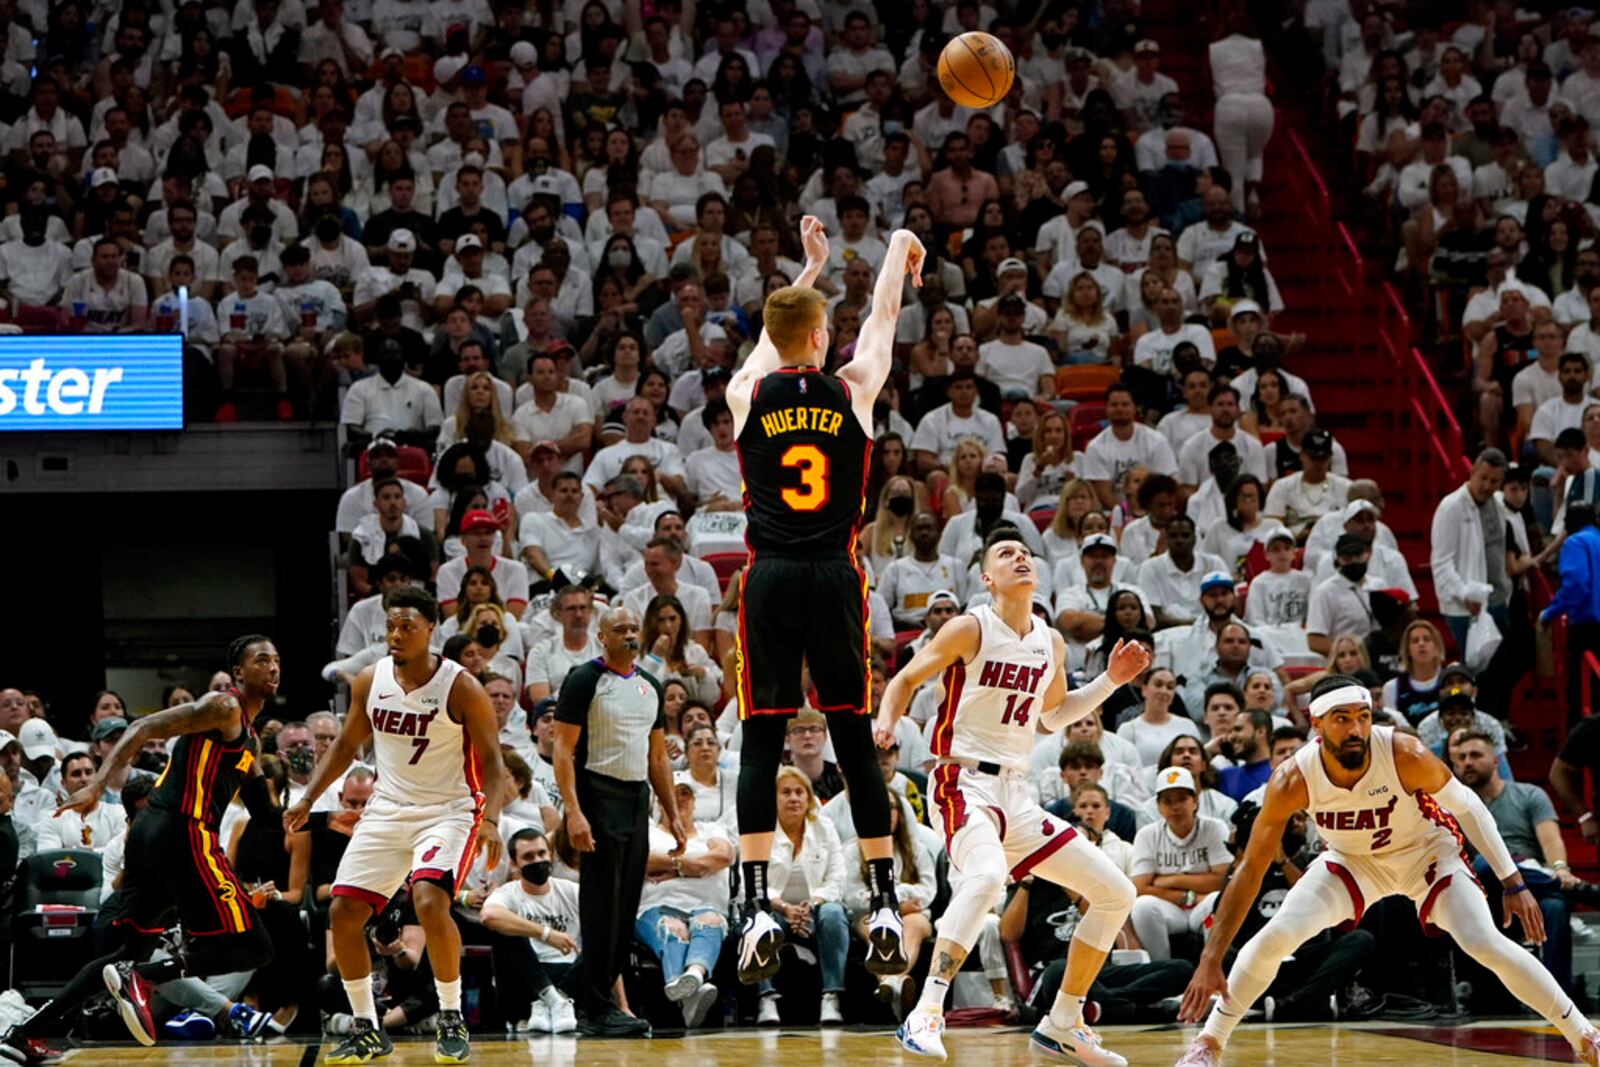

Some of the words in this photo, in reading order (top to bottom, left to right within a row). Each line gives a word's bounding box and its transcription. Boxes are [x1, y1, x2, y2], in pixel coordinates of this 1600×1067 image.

[761, 406, 843, 438] HUERTER
[780, 444, 830, 512] 3
[979, 661, 1047, 694] HEAT
[371, 707, 438, 737] HEAT
[1001, 693, 1035, 727] 14
[408, 738, 430, 765] 7
[1315, 794, 1398, 830] HEAT
[1370, 827, 1393, 850] 2
